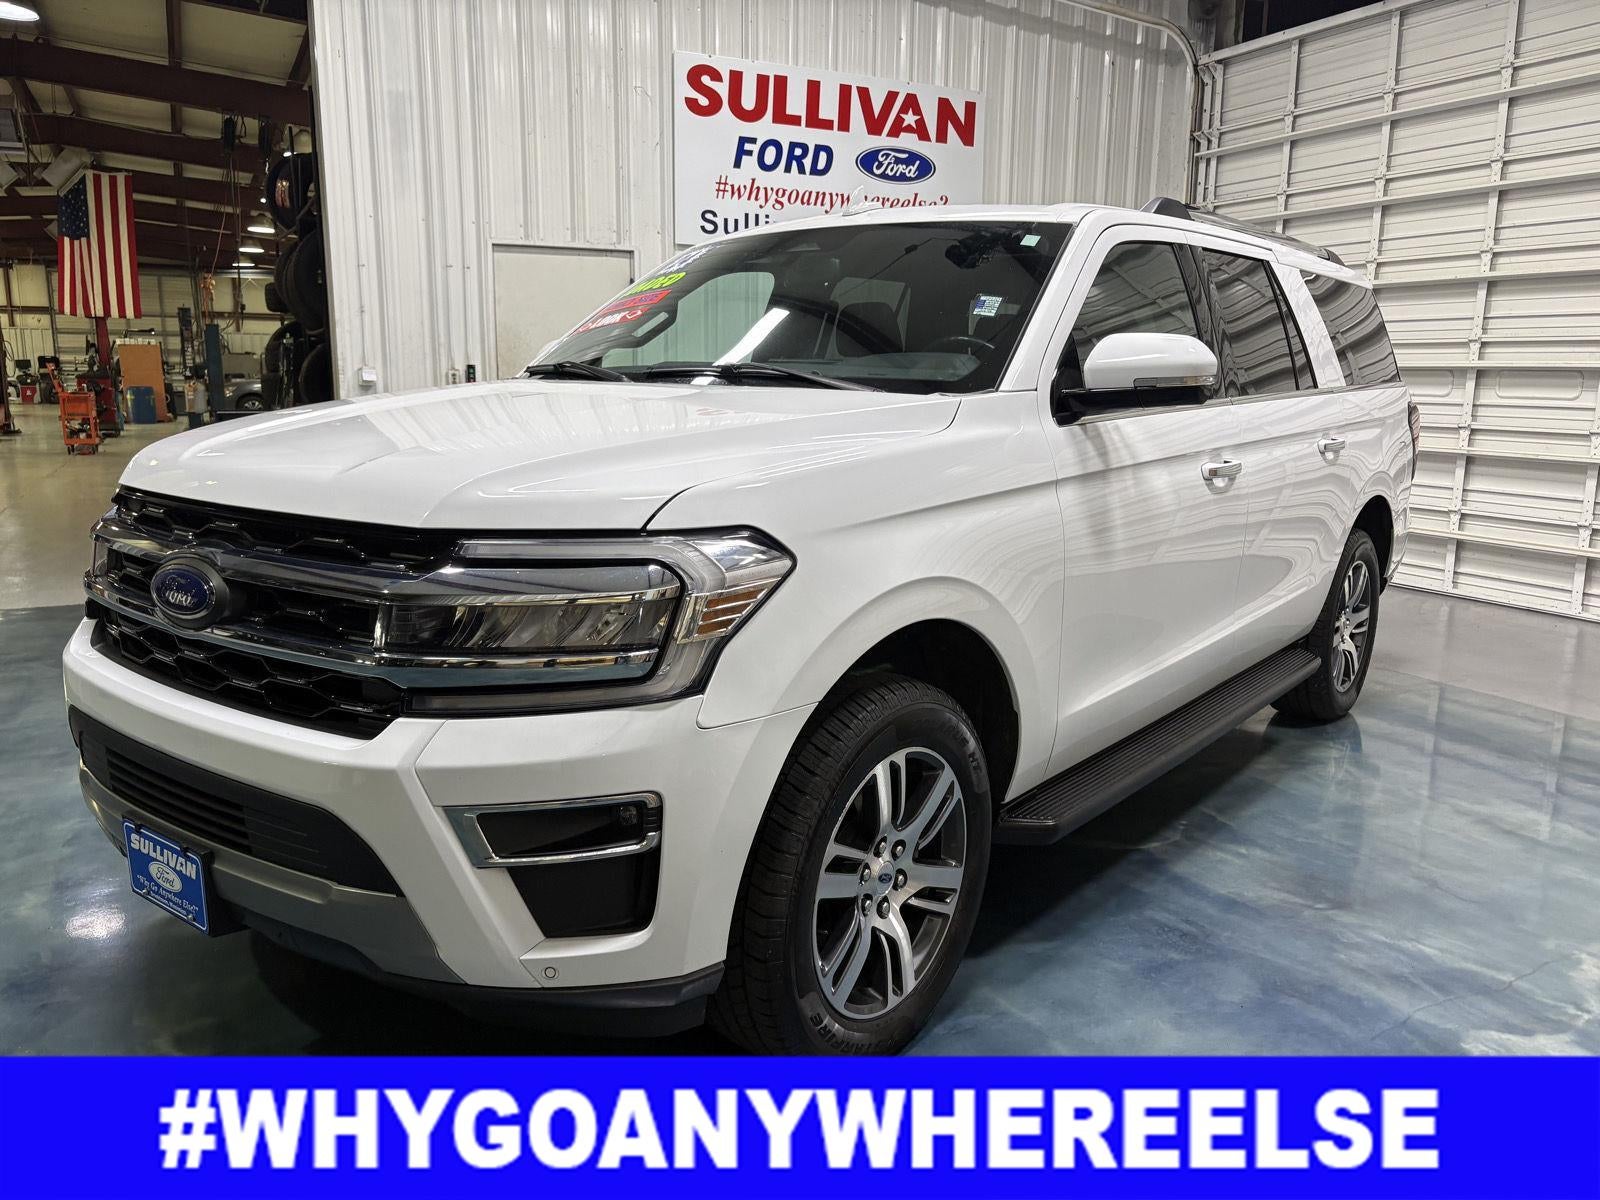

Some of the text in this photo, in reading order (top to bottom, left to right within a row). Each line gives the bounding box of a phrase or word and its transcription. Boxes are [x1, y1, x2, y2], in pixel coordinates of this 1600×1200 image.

[684, 63, 977, 147] SULLIVAN
[732, 135, 834, 177] FORD
[872, 149, 920, 178] Ford
[130, 833, 197, 880] SULLIVAN
[155, 866, 175, 888] Ford
